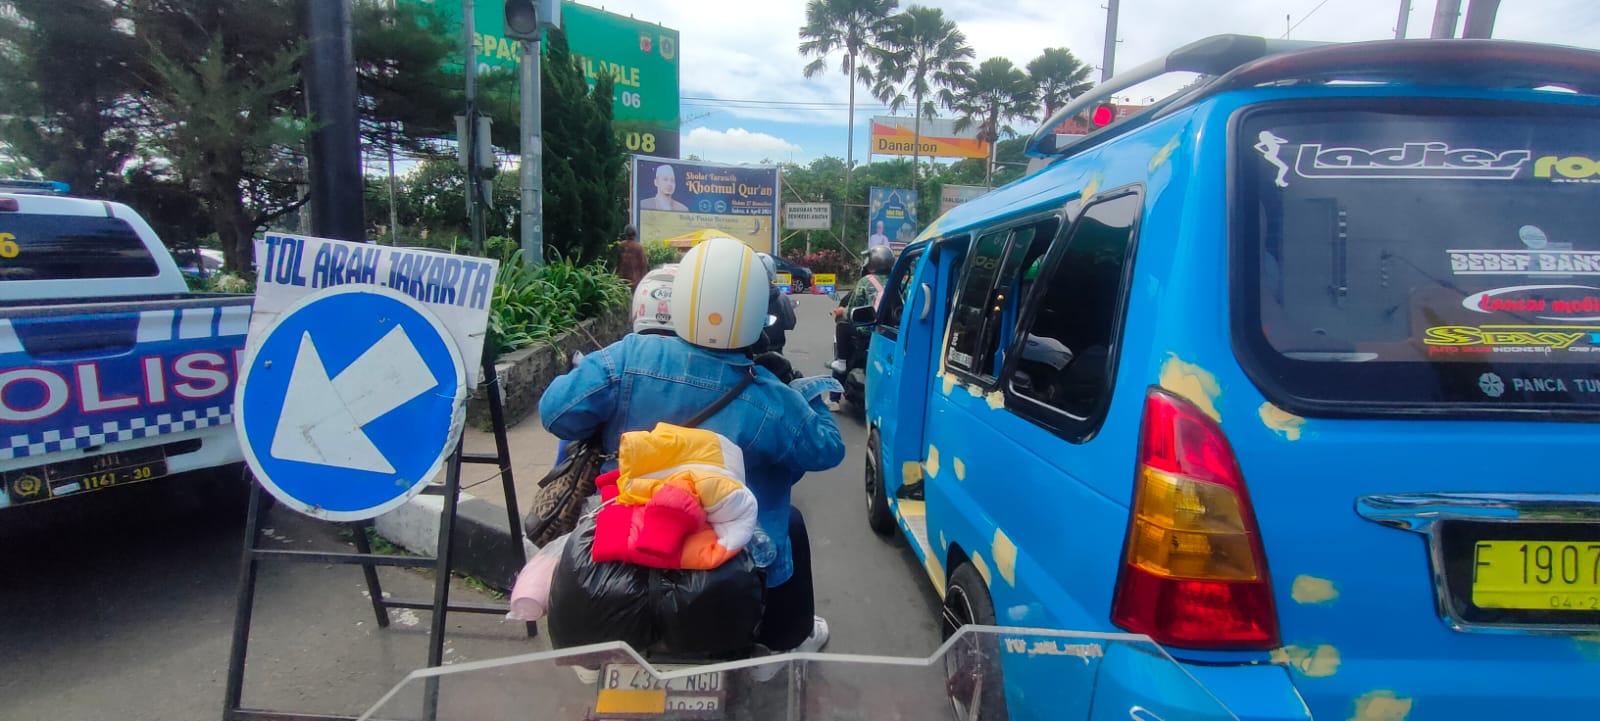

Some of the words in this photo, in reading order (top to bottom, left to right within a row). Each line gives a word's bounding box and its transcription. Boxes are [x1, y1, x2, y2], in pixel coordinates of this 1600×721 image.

[473, 32, 521, 63] SPAC
[625, 132, 656, 153] 08
[1294, 142, 1531, 180] Ladies
[1534, 156, 1600, 178] ro
[686, 180, 736, 195] Khotmul
[738, 183, 773, 198] Qur'an
[264, 235, 306, 288] TOL
[312, 244, 376, 287] ARAH
[1512, 378, 1568, 392] PANCA
[133, 466, 151, 480] 30
[1474, 544, 1492, 583] F
[1520, 544, 1600, 584] 1907
[609, 669, 619, 689] B
